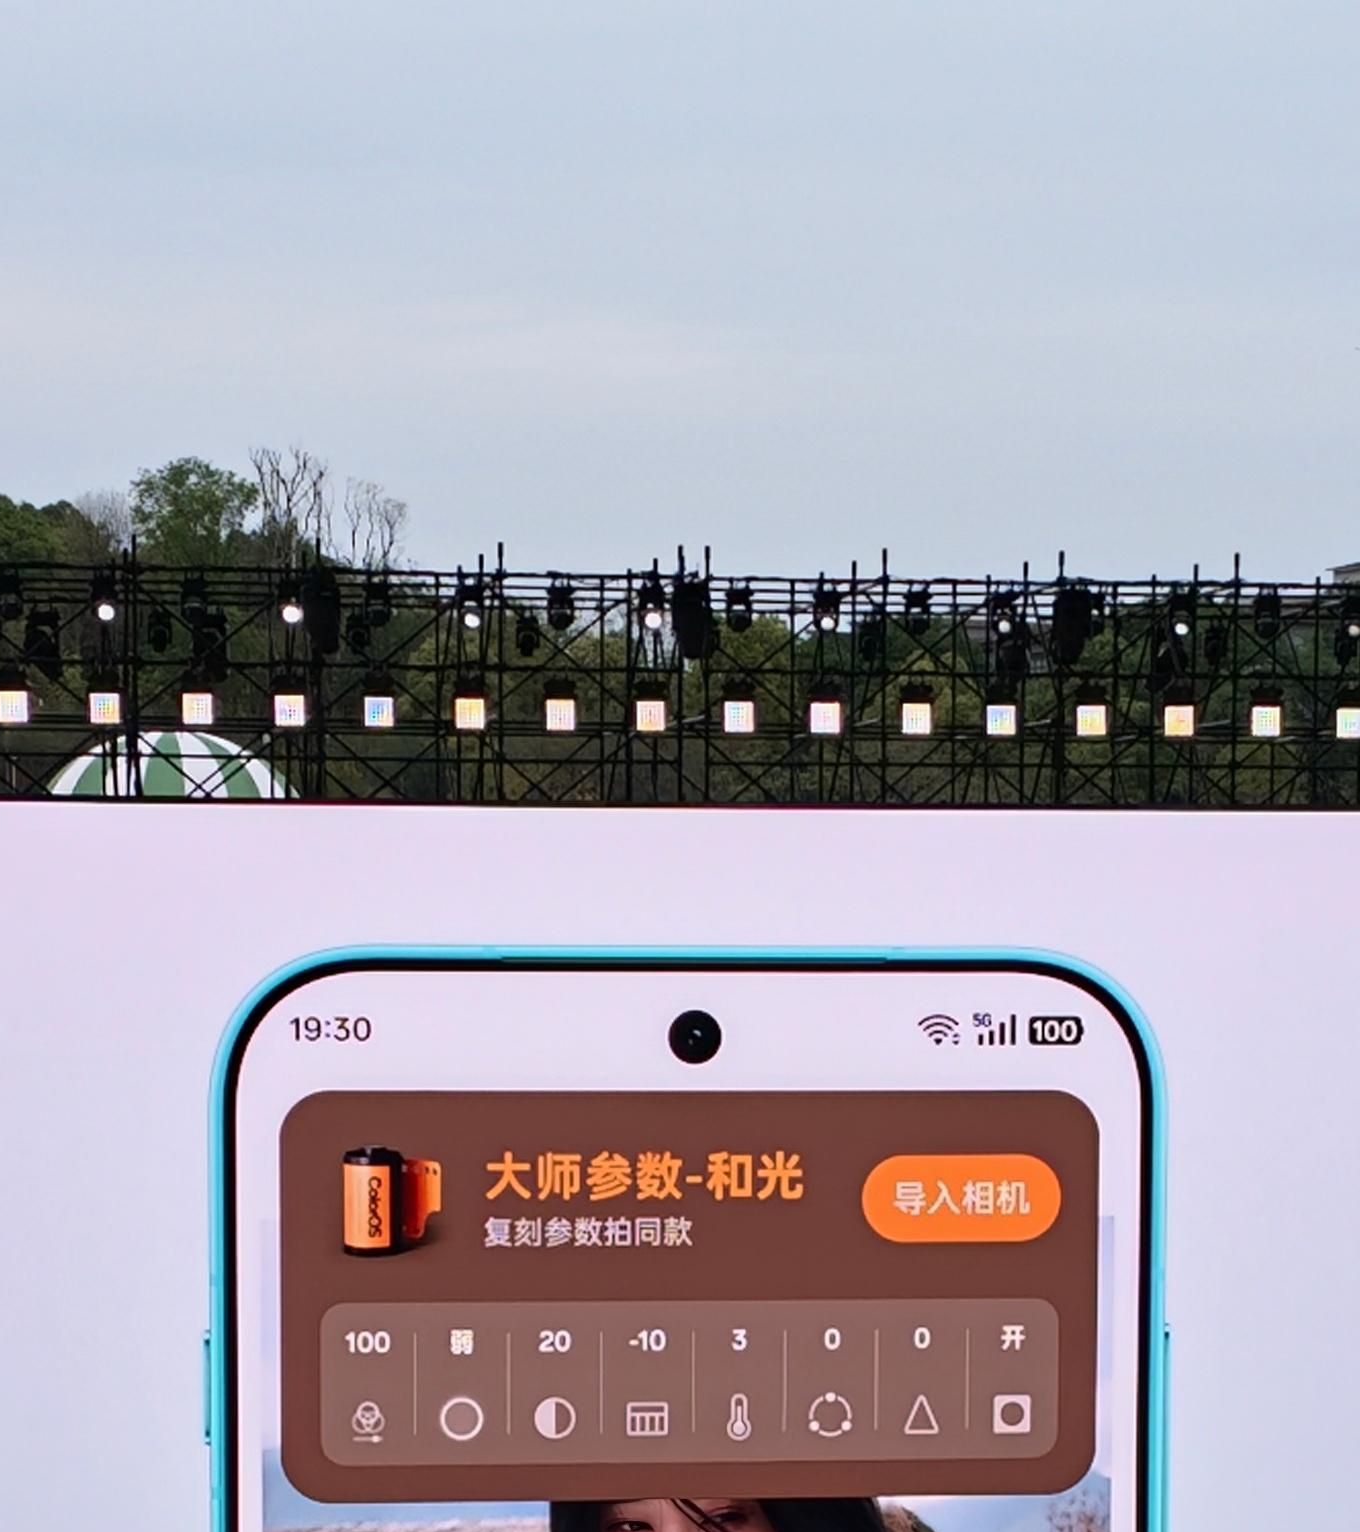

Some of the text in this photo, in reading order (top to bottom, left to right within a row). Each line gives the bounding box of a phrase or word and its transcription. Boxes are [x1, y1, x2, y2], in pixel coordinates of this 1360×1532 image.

[290, 1016, 372, 1042] 19:30
[972, 1012, 991, 1028] 5G
[1032, 1019, 1078, 1042] 100
[485, 1150, 804, 1201] 大师参数-和光
[368, 1175, 382, 1238] ColorOS
[893, 1180, 1031, 1216] 导入相机
[484, 1216, 693, 1247] 复刻参数拍同款
[345, 1331, 391, 1354] 100
[538, 1330, 572, 1353] 20
[628, 1329, 667, 1352] -10
[731, 1328, 747, 1351] 3
[823, 1328, 841, 1351] 0
[913, 1326, 931, 1349] 0
[1000, 1325, 1026, 1351] 开
